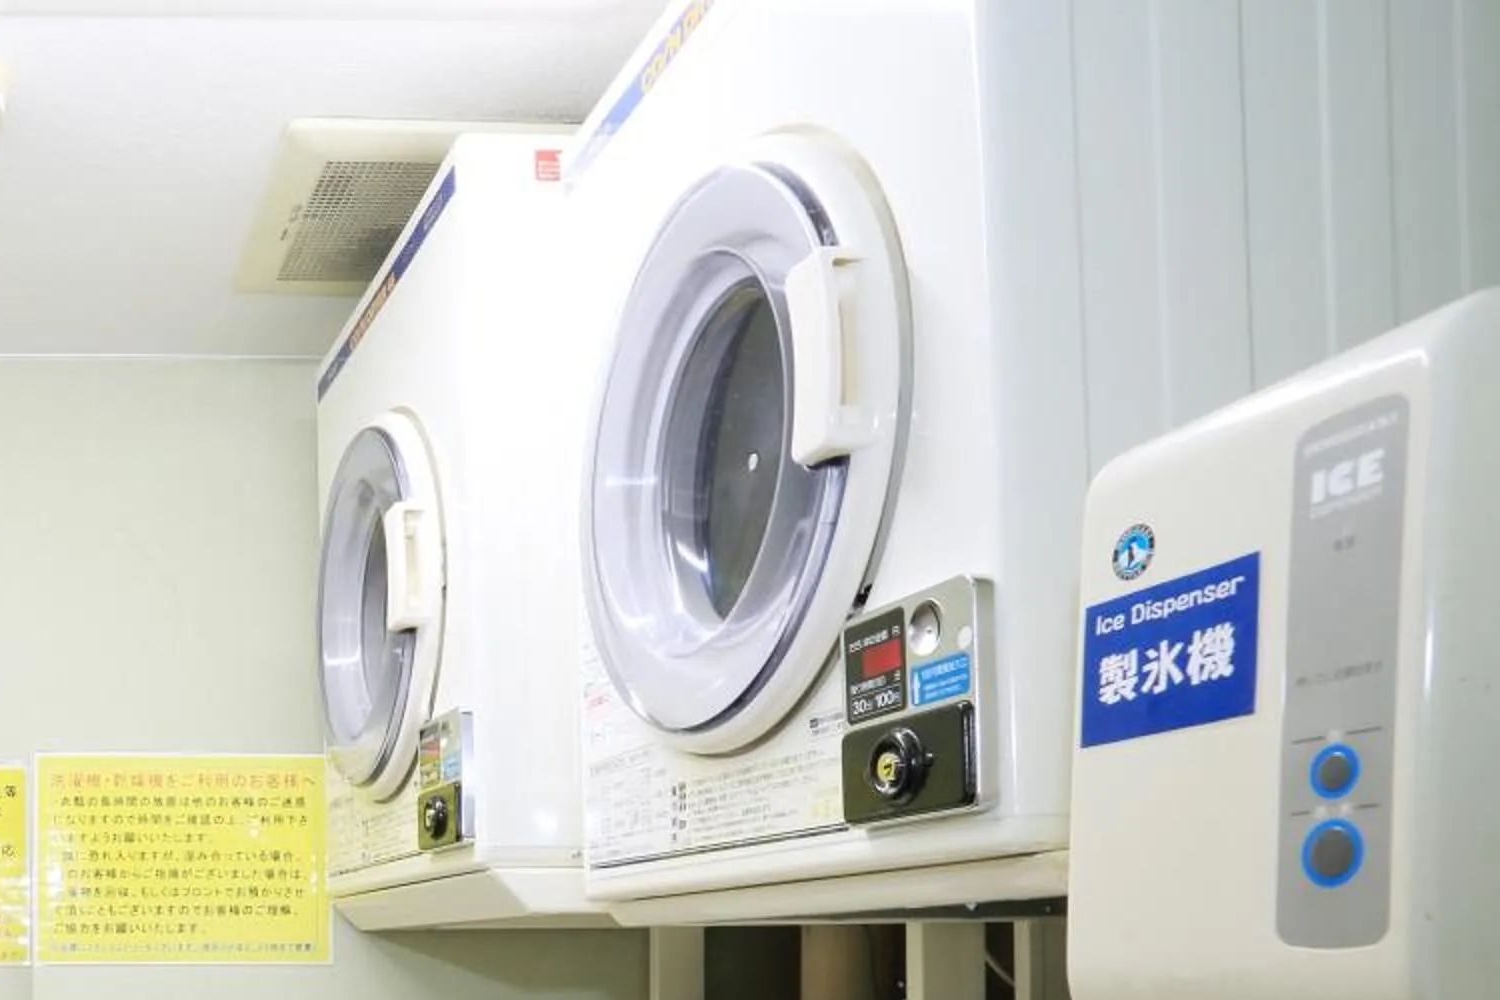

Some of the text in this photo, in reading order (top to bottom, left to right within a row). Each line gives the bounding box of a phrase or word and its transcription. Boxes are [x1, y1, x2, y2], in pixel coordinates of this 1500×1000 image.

[1311, 448, 1385, 504] ICE
[1094, 573, 1246, 637] Ice Dispenser
[1097, 621, 1237, 707] 製氷機
